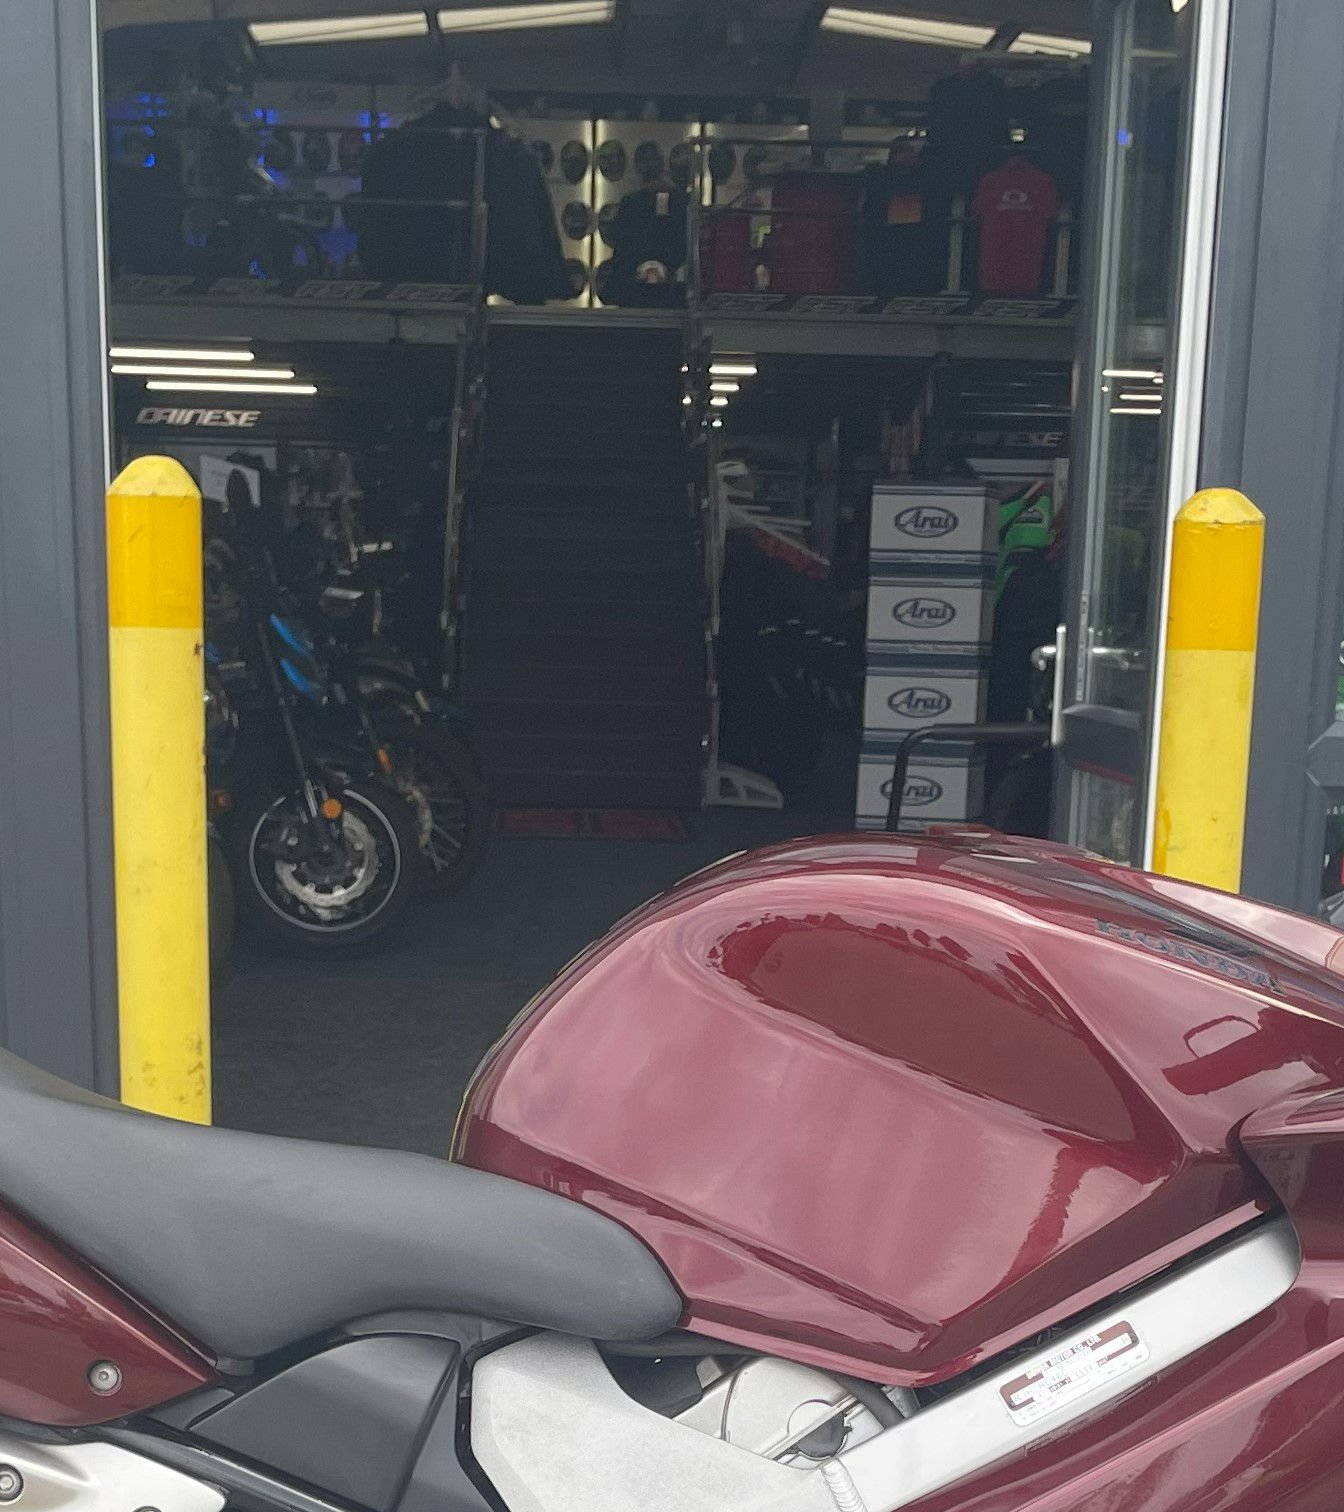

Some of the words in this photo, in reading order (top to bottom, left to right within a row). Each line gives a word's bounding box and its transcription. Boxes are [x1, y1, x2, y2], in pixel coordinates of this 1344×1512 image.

[135, 407, 261, 427] DAINESE
[899, 509, 951, 529] Arai
[897, 599, 949, 620] Arai
[896, 689, 945, 710] Arai
